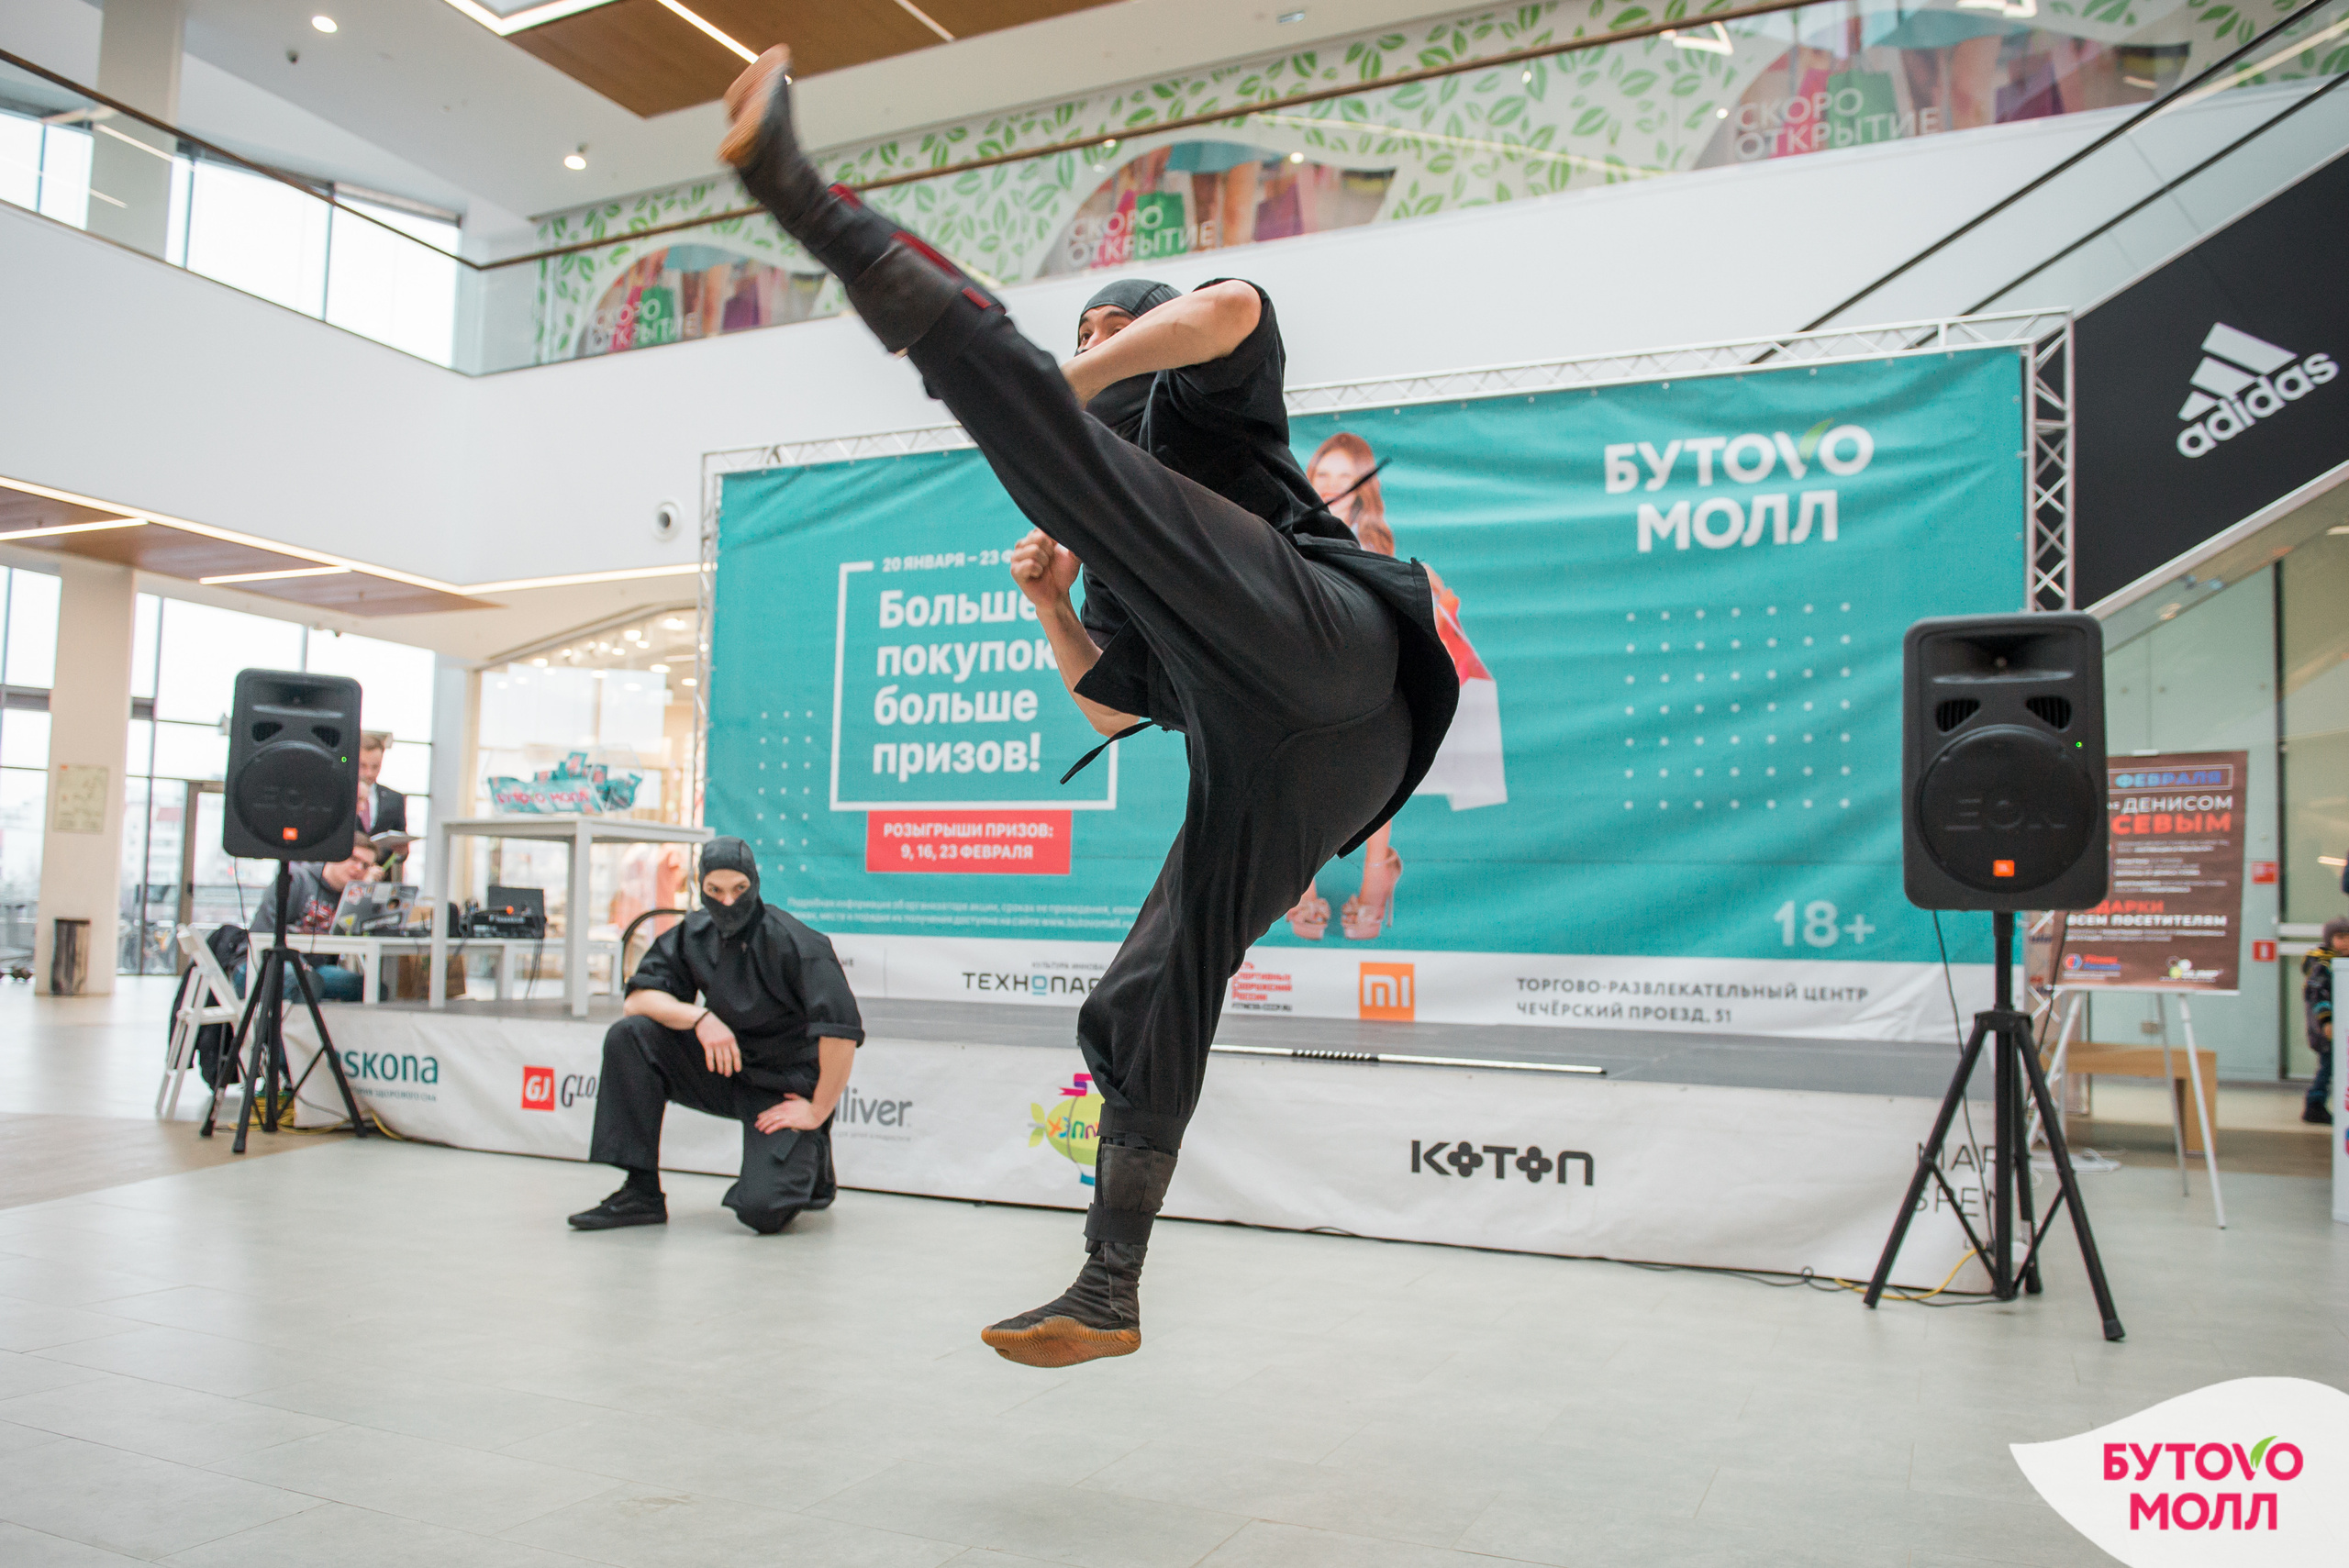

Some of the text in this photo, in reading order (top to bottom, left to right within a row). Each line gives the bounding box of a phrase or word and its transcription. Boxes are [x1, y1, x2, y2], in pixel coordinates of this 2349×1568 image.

[1736, 87, 1864, 130] СКОРО
[1736, 106, 1940, 161] ОТКРЫТИЕ
[1069, 206, 1164, 241] СКОРО
[1067, 220, 1216, 267] ОТКРЫТИЕ
[2176, 352, 2340, 458] adidas
[1637, 489, 1838, 553] МОЛЛ
[882, 556, 902, 573] 20
[903, 552, 965, 571] ЯНВАРЯ
[979, 550, 999, 566] 23
[879, 588, 1039, 628] Больше
[876, 639, 1058, 683] покупок
[874, 685, 1039, 726] больше
[873, 732, 1041, 783] призов!
[2115, 771, 2221, 788] ФЕВРАЛЯ
[2121, 795, 2232, 814] ДЕНИСОМ
[883, 823, 1054, 839] РОЗЫГРЫШИ ПРИЗОВ:
[2110, 812, 2232, 836] СЕВЫМ
[900, 843, 1034, 862] 9, 16, 23 ФЕВРАЛЯ
[1774, 900, 1876, 948] 18+
[2066, 914, 2229, 928] ВСЕМ ПОСЕТИТЕЛЯМ
[2087, 899, 2165, 915] ДАРКИ
[962, 973, 1101, 995] ТЕХНОПАР
[1517, 977, 1868, 1002] ТОРГОВО-РАЗВЛЕКАТЕЛЬНЫЙ ЦЕНТР
[1517, 1000, 1623, 1018] ЧЕЧЁРСКИЙ
[1715, 1008, 1732, 1023] 51
[525, 1074, 596, 1107] GJ GLO
[833, 1086, 913, 1127] lliver
[1410, 1140, 1594, 1186] KOTON
